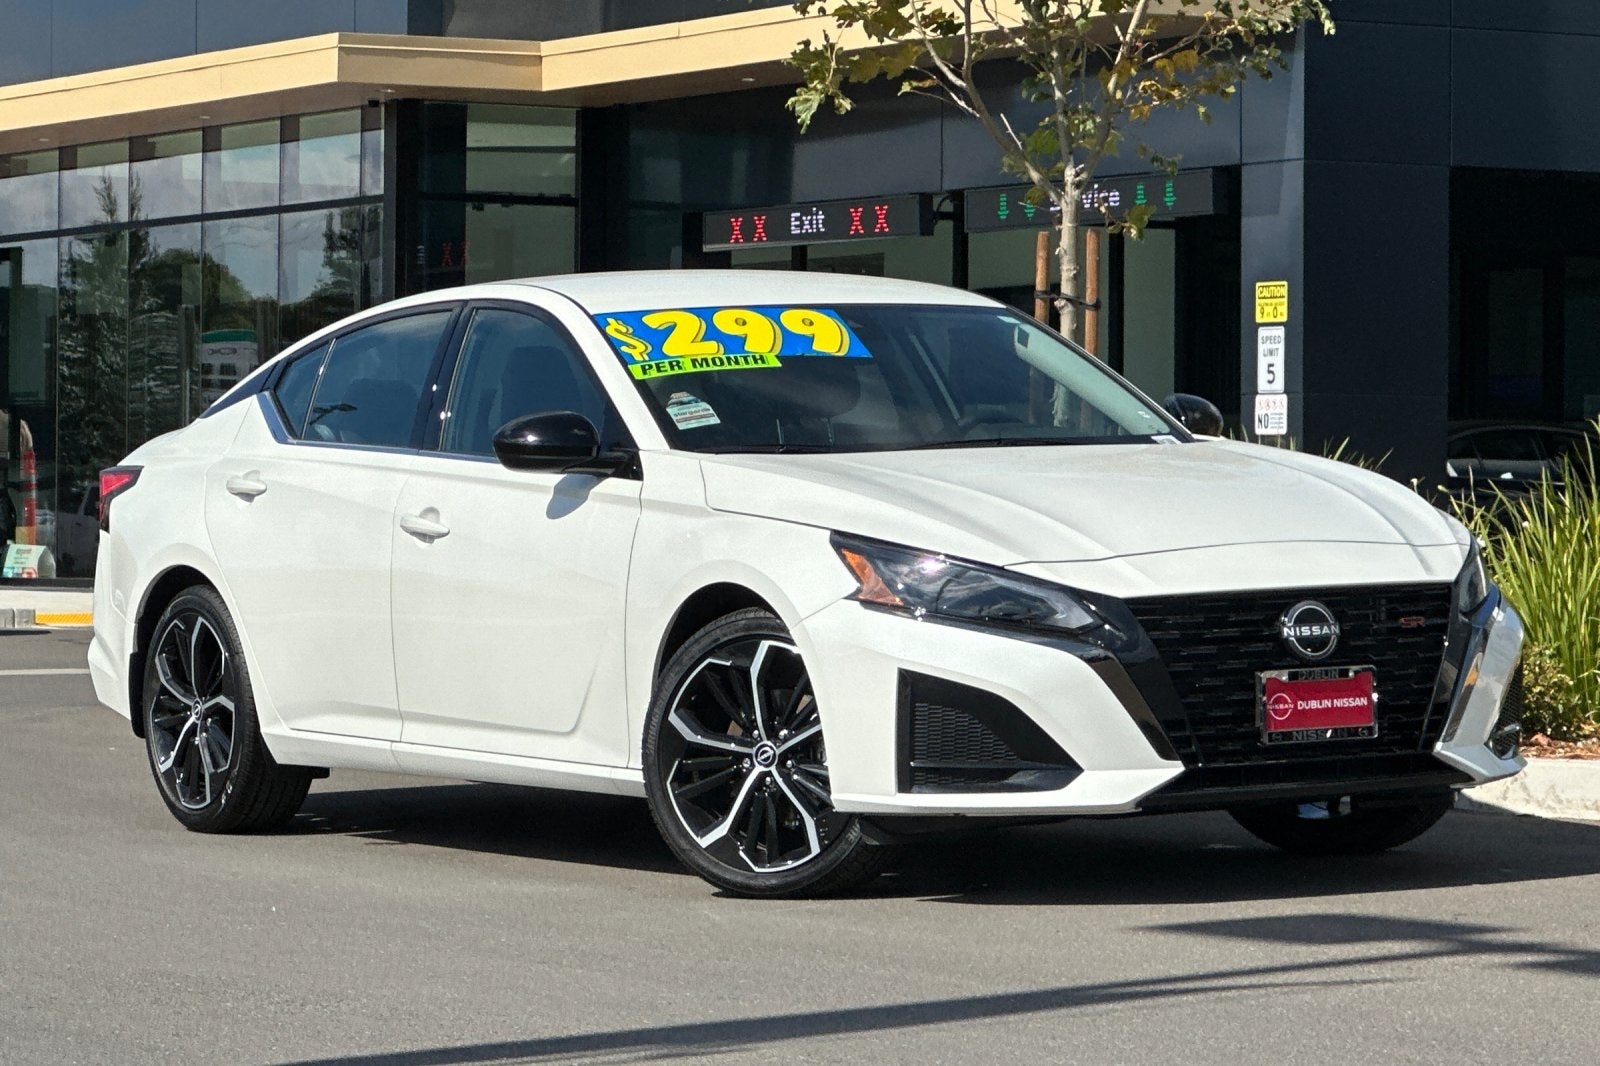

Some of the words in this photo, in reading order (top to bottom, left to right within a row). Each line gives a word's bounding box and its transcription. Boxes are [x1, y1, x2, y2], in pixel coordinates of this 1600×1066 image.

[1050, 183, 1120, 211] vice
[791, 207, 825, 234] Exit
[1259, 286, 1285, 298] CAUTION
[1261, 335, 1282, 345] SPEED
[1263, 348, 1280, 357] LIMIT
[641, 359, 682, 376] PER
[691, 354, 767, 370] MONTH
[1266, 363, 1276, 385] 5
[1257, 413, 1269, 429] NO
[1283, 624, 1340, 637] NISSAN
[1298, 669, 1339, 680] DUBLIN
[1297, 700, 1332, 710] DUBLIN
[1333, 697, 1368, 708] NISSAN
